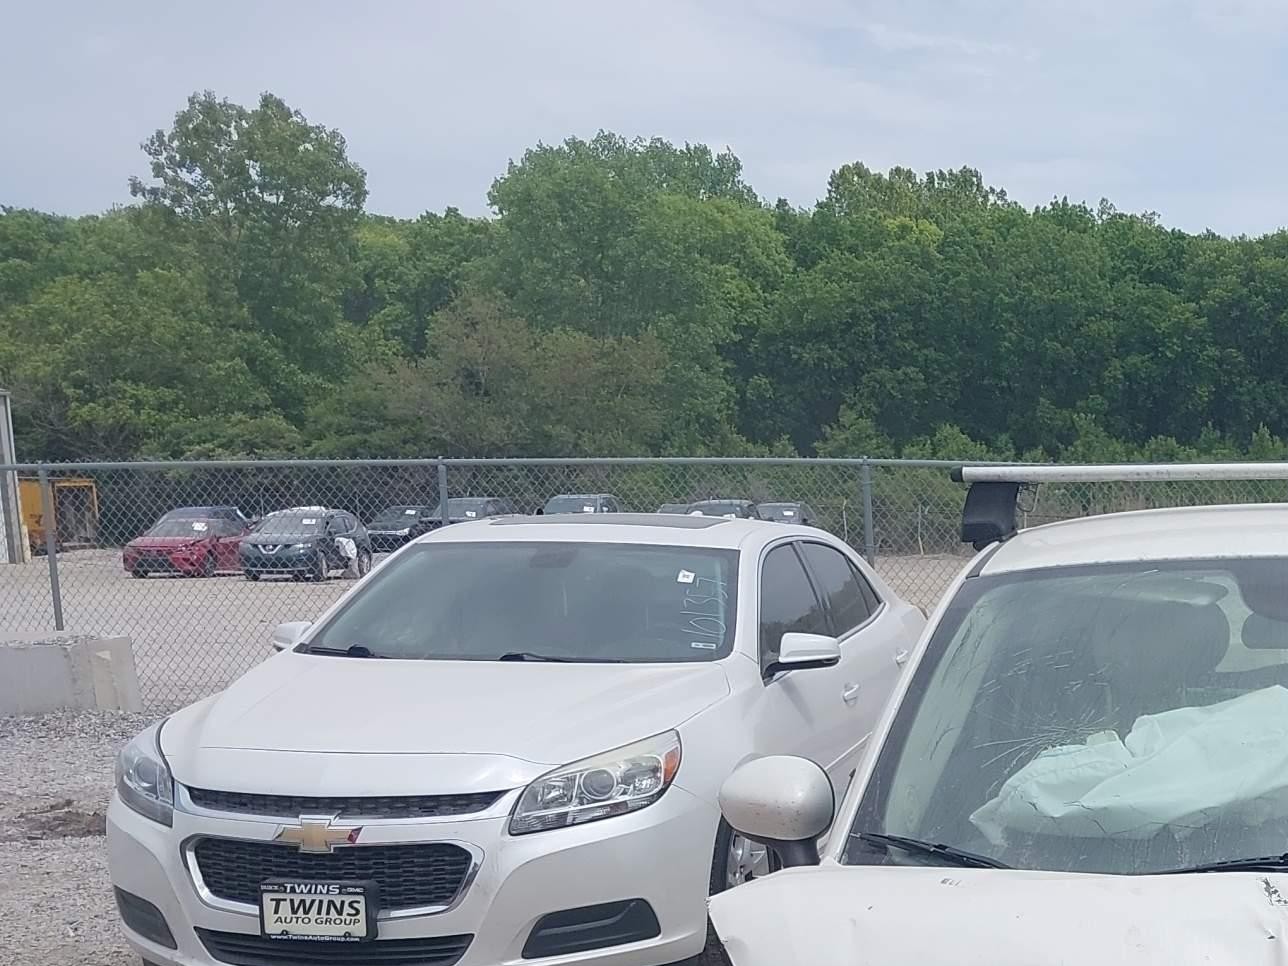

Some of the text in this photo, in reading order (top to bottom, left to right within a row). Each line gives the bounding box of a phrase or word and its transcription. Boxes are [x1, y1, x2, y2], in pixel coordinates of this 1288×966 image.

[284, 883, 340, 895] TWINS
[270, 898, 361, 917] TWINS
[274, 916, 361, 926] AUTO GROUP
